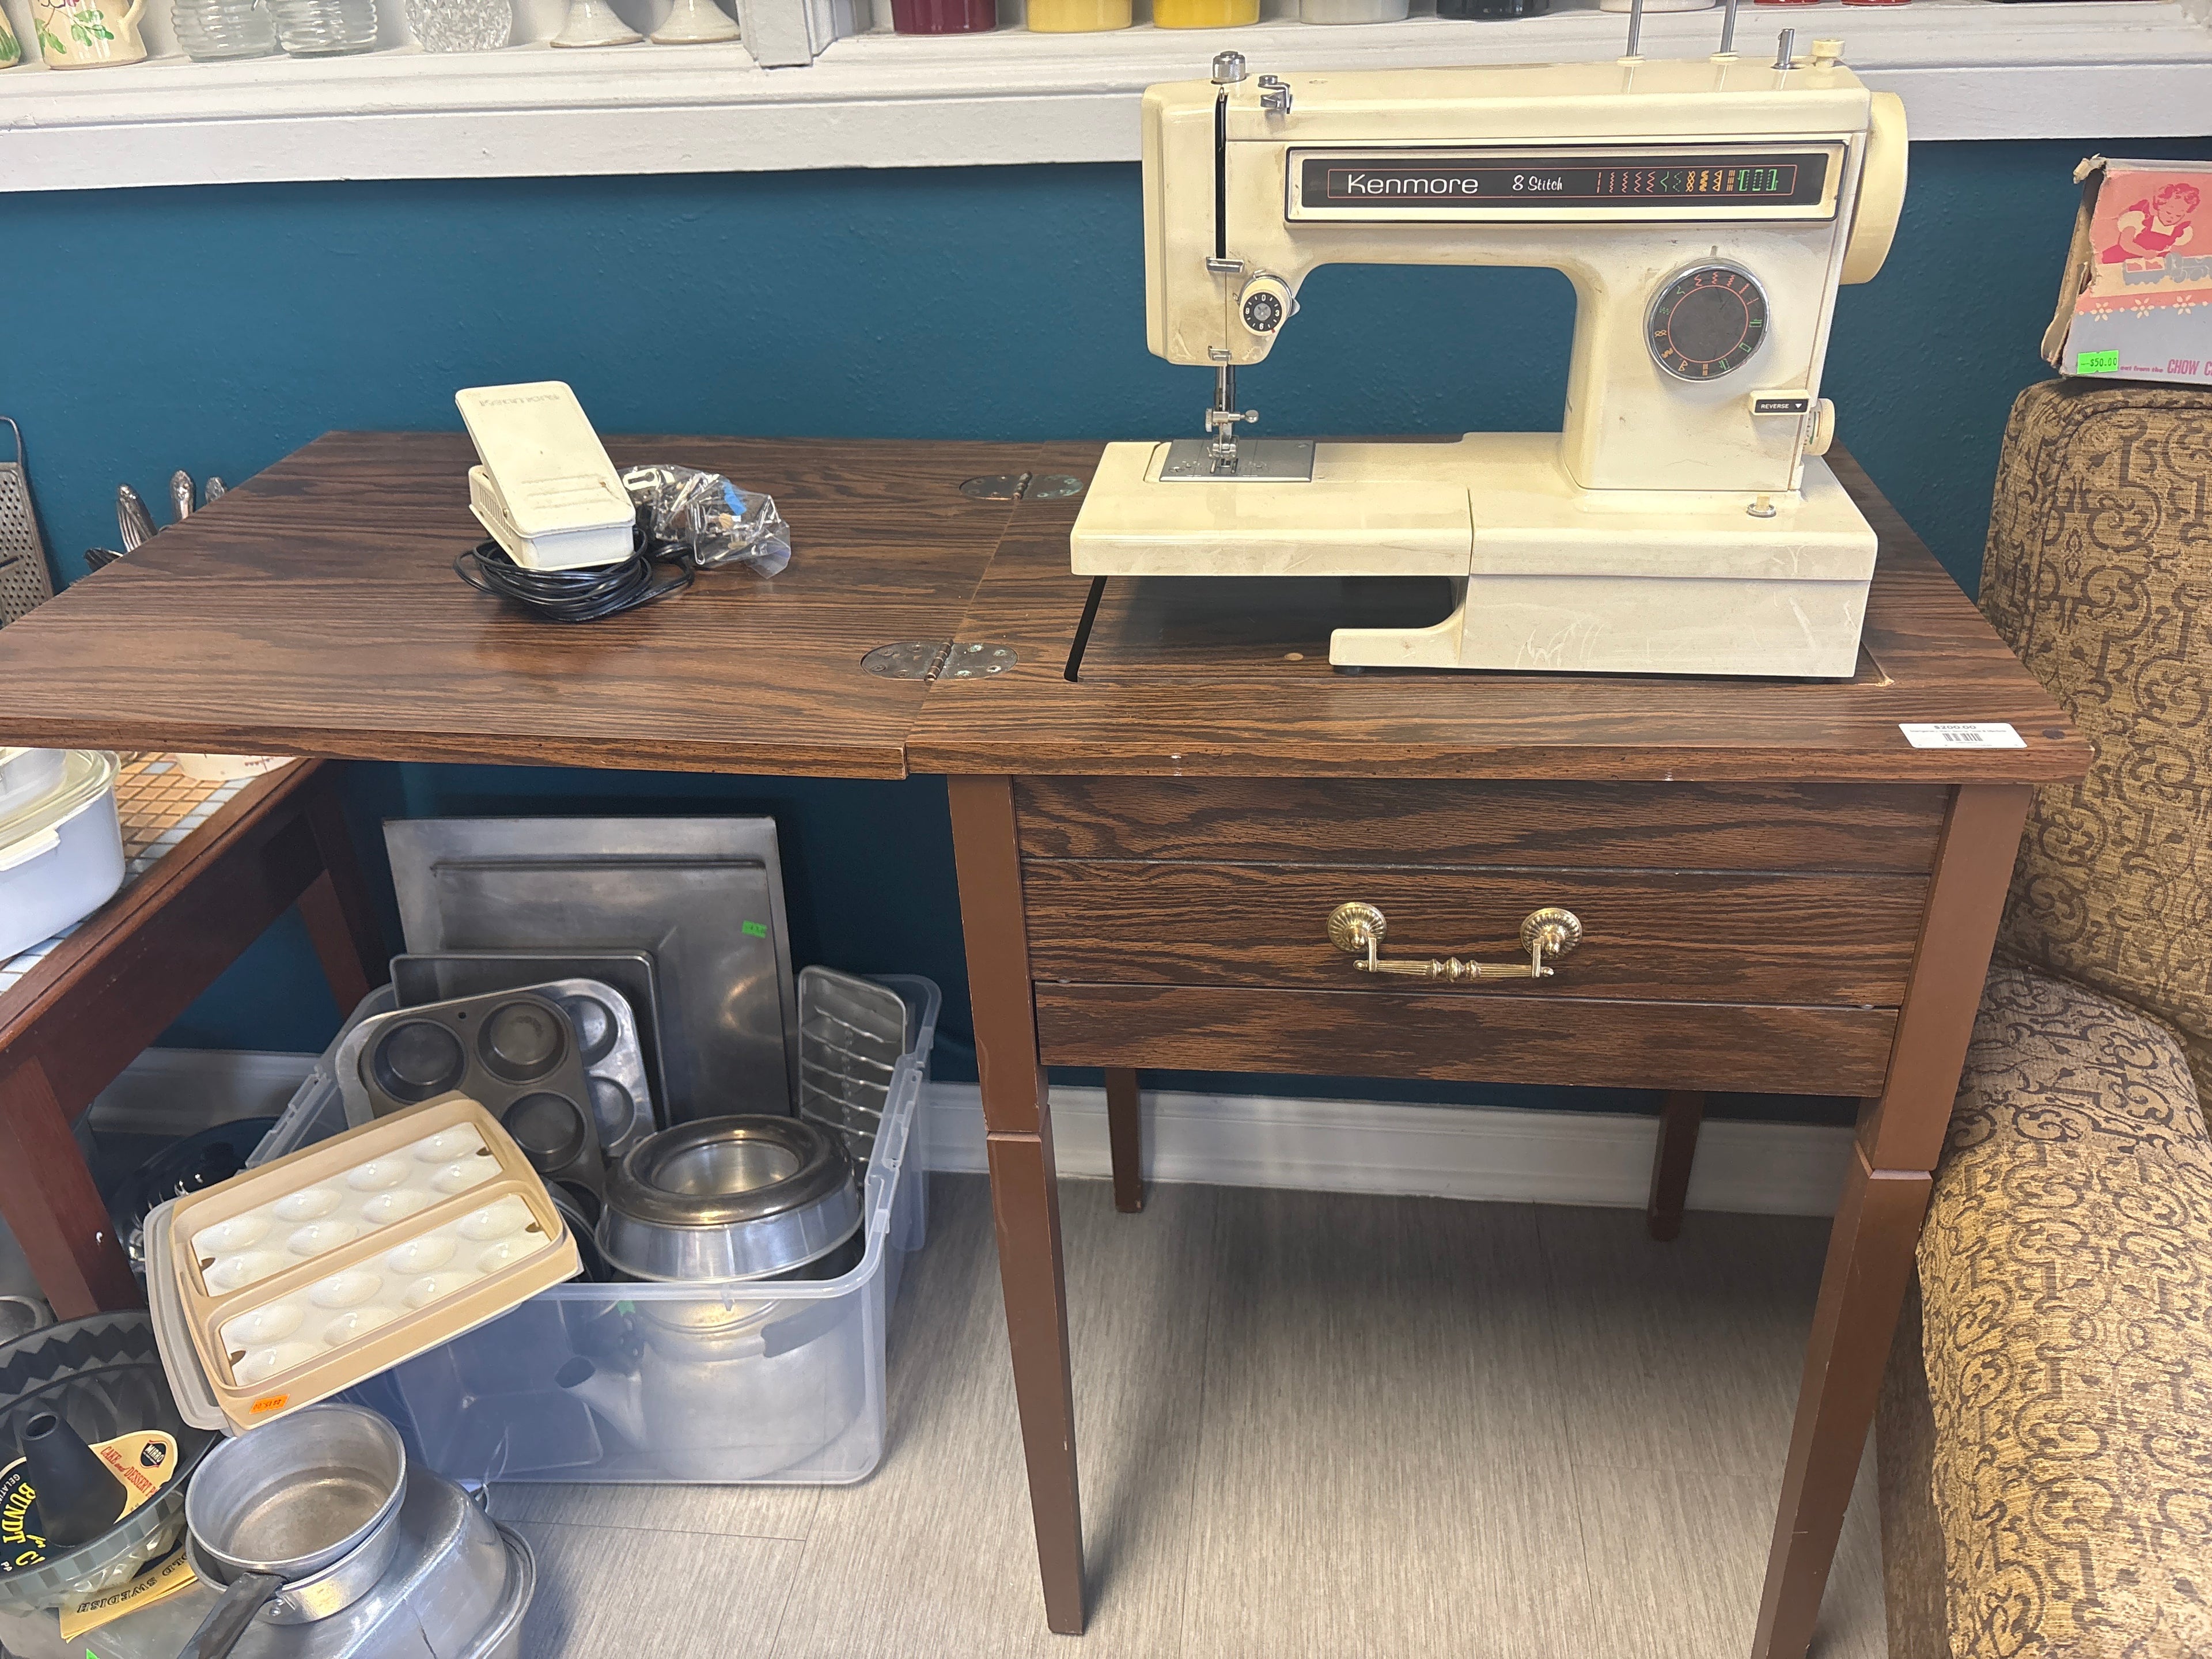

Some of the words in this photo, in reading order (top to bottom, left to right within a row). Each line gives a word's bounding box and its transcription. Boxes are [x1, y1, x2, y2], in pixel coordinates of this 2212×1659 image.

[1347, 173, 1479, 194] Kenmore
[1512, 174, 1525, 191] 8
[1527, 175, 1563, 192] Stitch
[2166, 359, 2200, 376] CHOW
[2203, 361, 2212, 376] C
[144, 1444, 165, 1463] MIRRO
[100, 1446, 122, 1464] CAKE
[114, 1463, 131, 1472] and
[124, 1466, 153, 1494] DESSERT
[0, 1474, 21, 1505] GELATI
[2, 1482, 36, 1544] BUNDT
[77, 1576, 158, 1613] SWEDISH
